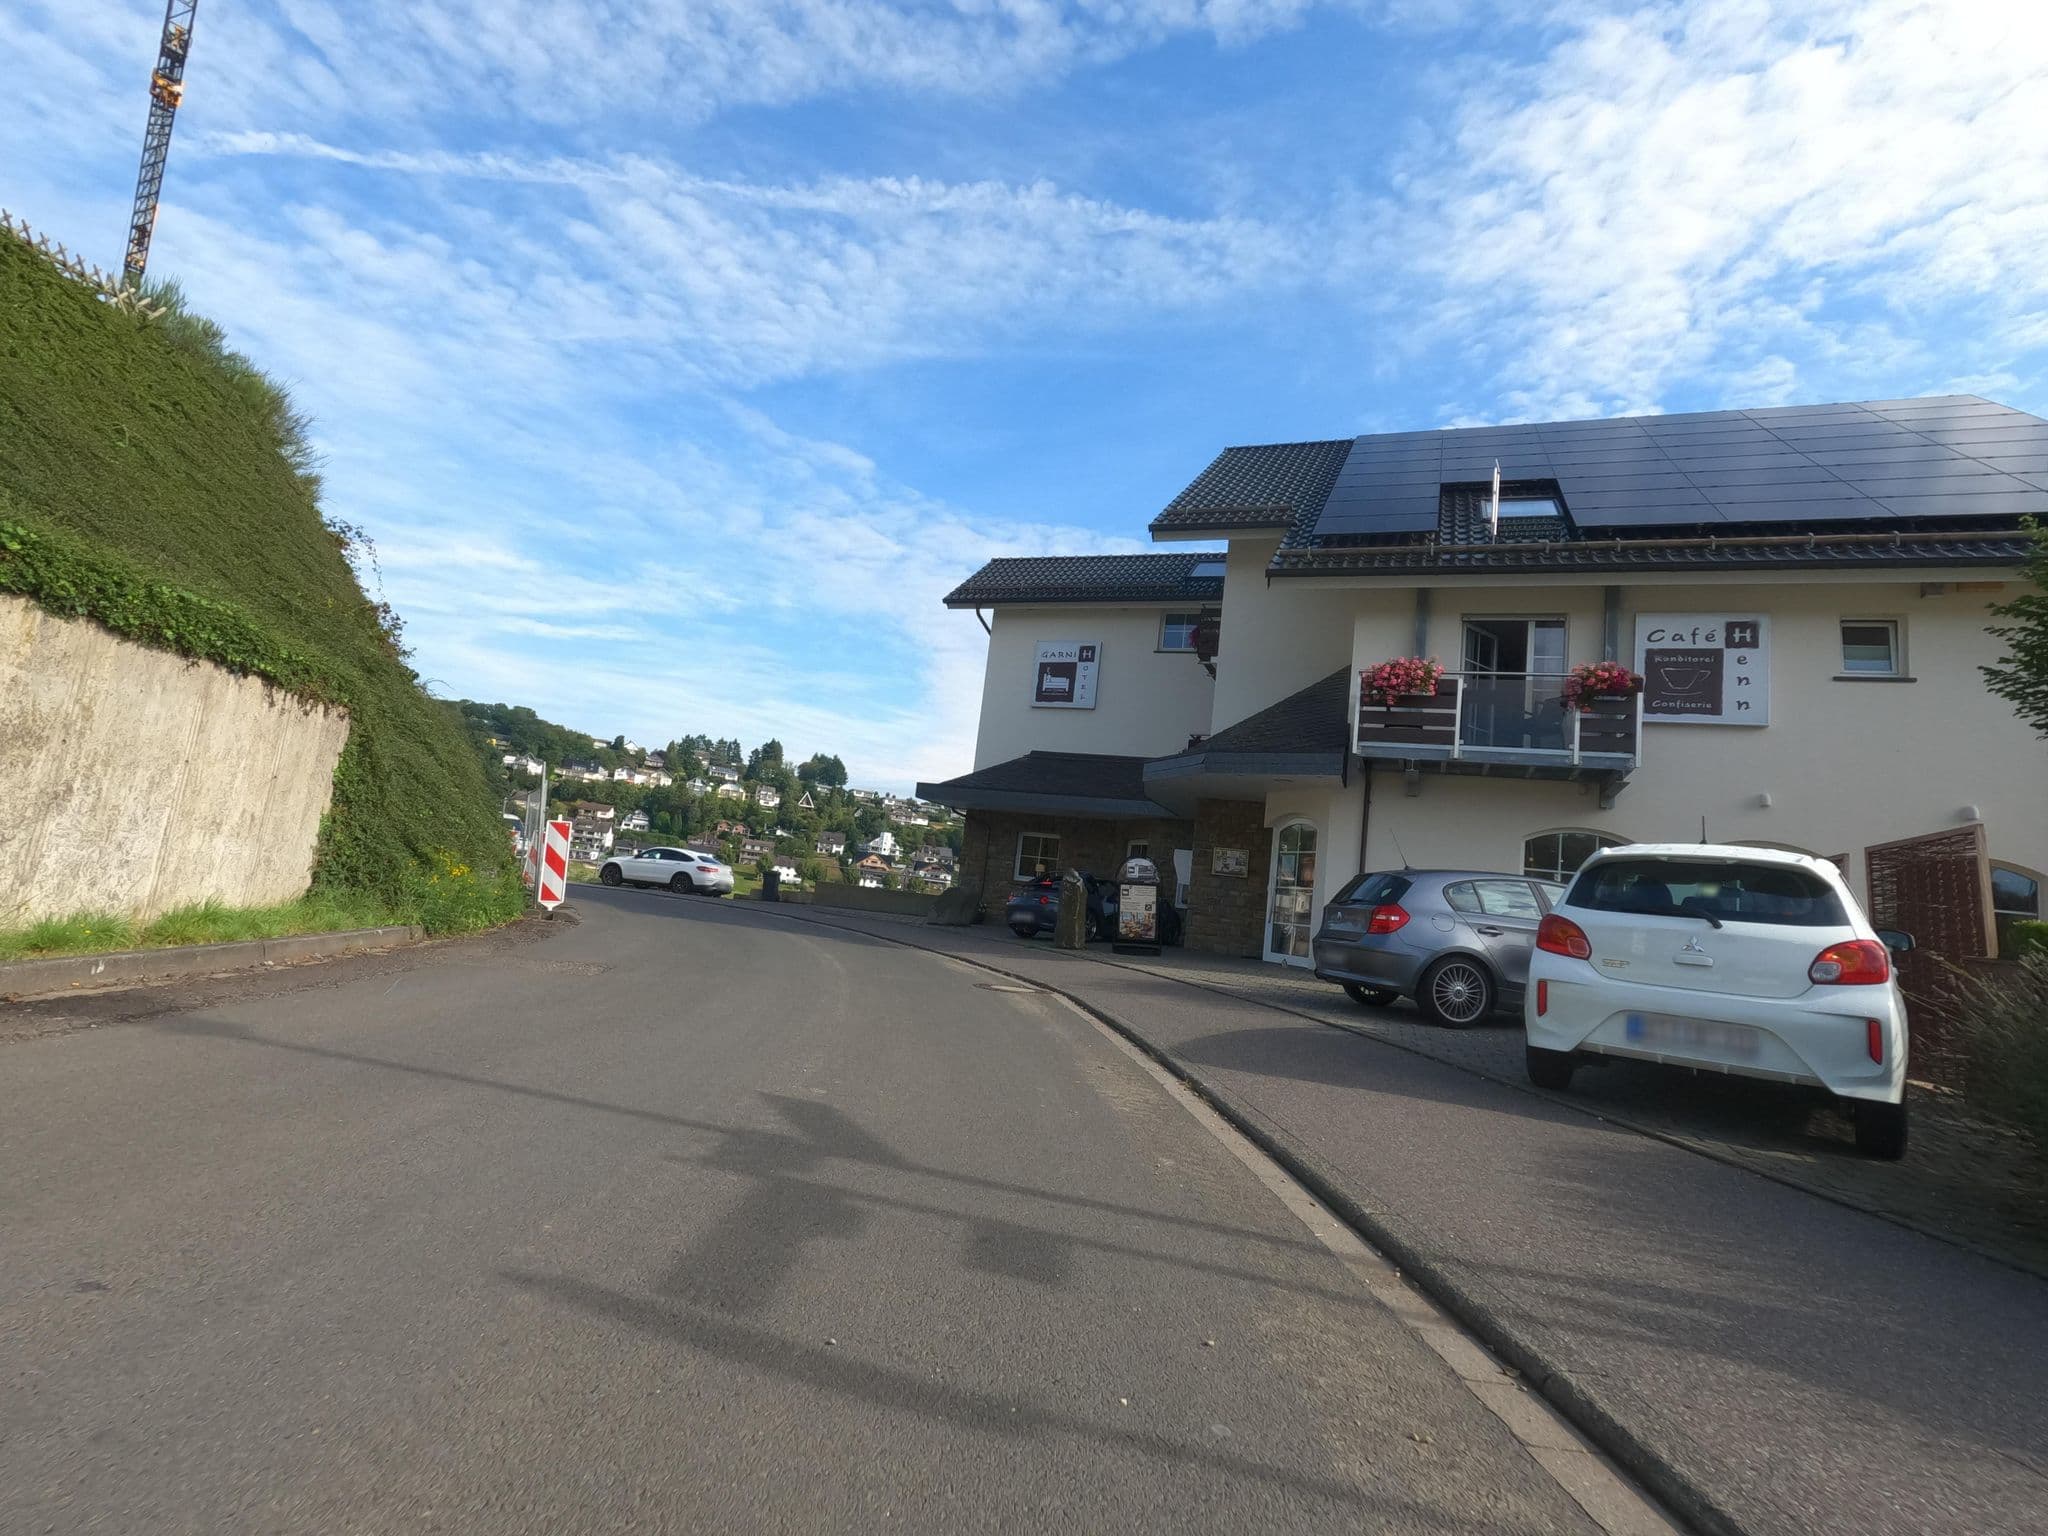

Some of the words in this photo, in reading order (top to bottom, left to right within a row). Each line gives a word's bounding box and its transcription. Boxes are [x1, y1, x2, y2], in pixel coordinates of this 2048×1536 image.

[1646, 627, 1717, 645] Café
[1654, 655, 1715, 663] Konditorei
[1080, 649, 1092, 700] HOTEL
[1733, 627, 1753, 711] Henn
[1652, 700, 1712, 709] Confiserie
